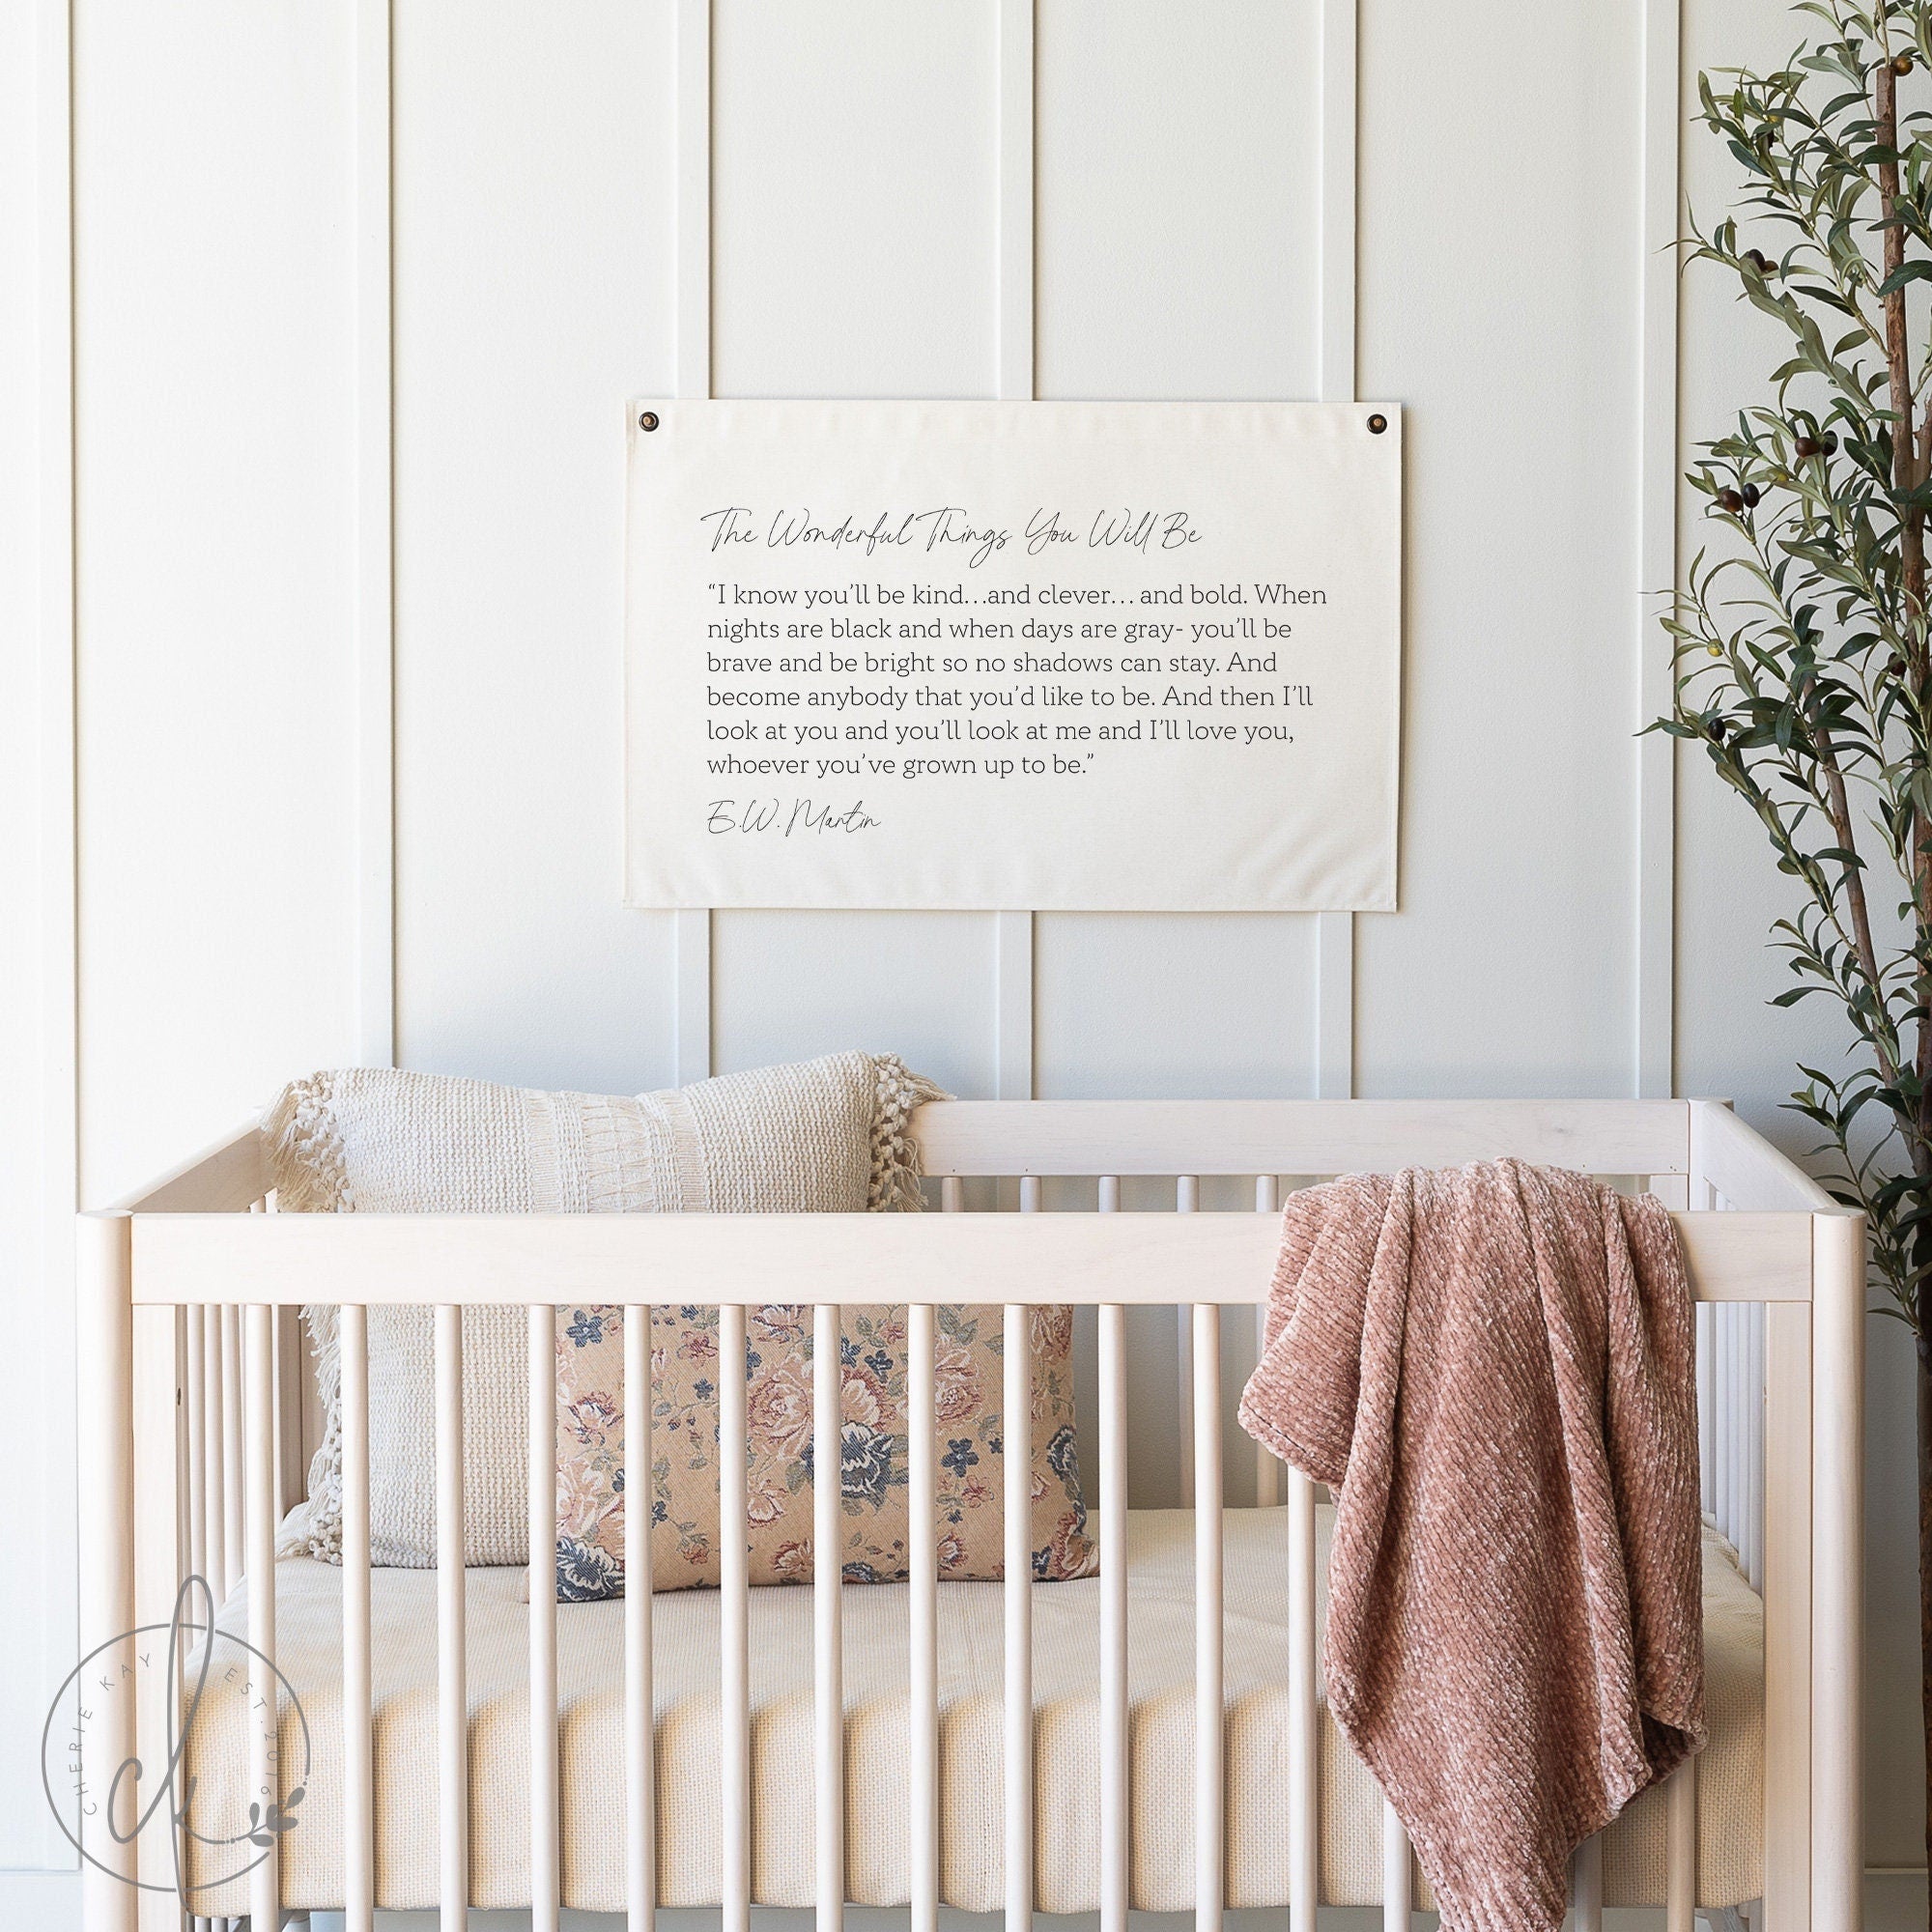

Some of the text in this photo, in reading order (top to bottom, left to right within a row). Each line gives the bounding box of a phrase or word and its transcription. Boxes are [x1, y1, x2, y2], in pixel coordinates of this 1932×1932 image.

[700, 507, 1205, 570] The Wonderful Things You Will Be
[734, 584, 798, 604] know
[805, 583, 870, 609] you’ll
[877, 584, 904, 604] be
[1141, 584, 1183, 604] and
[1190, 584, 1247, 604] bold.
[1254, 584, 1328, 604] When
[708, 617, 1292, 643] nights are black and when days are gray- you’ll be
[707, 652, 1277, 677] brave and be bright so no shadows can stay. And
[707, 685, 1313, 711] become anybody that you’d like to be. And then I’ll
[707, 720, 1296, 745] look at you and you’ll look at me and I’ll love you,
[707, 753, 810, 774] whoever
[816, 753, 895, 780] you’ve
[903, 758, 977, 779] grown
[984, 760, 1013, 779] up
[1022, 757, 1045, 774] to
[707, 798, 882, 838] E.W. Martin
